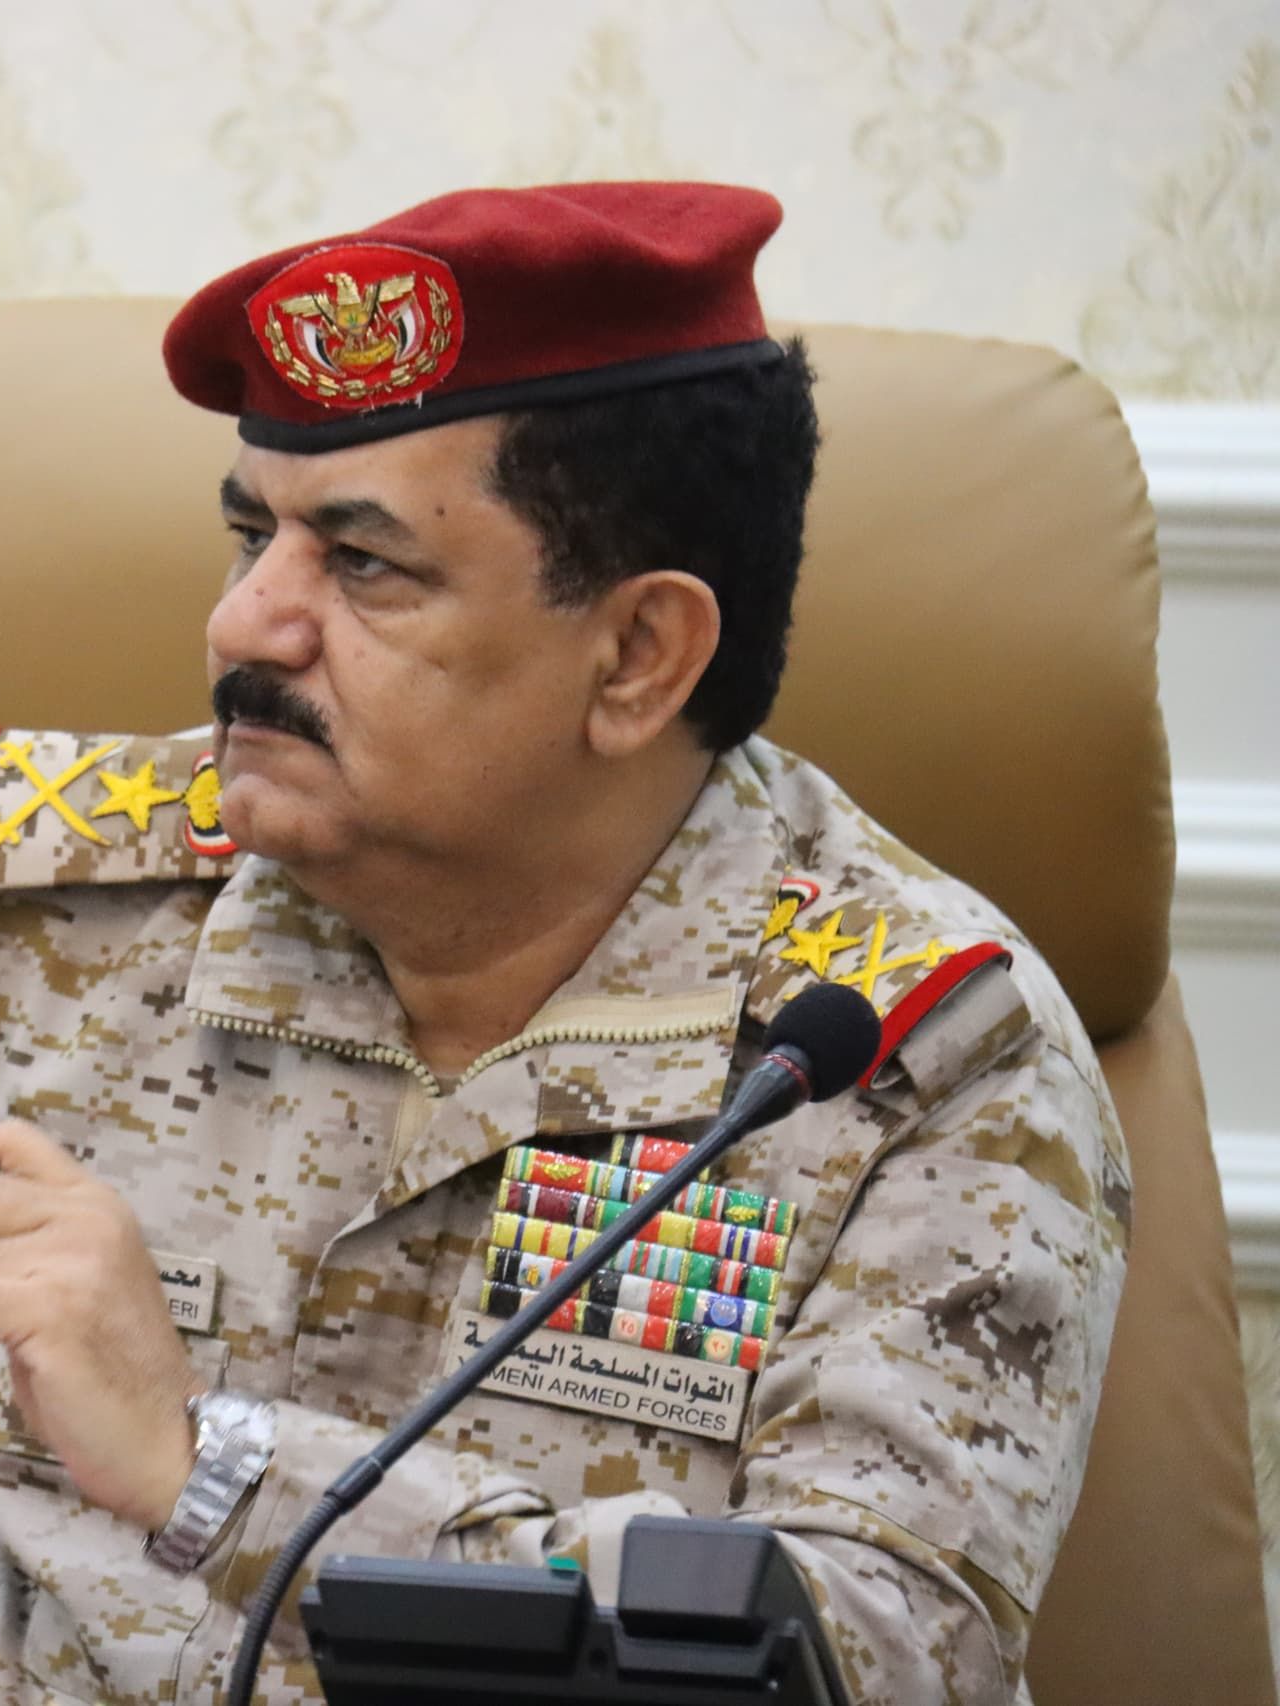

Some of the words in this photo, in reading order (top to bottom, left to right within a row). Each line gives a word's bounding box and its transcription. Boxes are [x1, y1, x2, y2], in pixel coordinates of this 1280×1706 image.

[159, 1269, 201, 1288] محس
[168, 1298, 199, 1319] ERI
[463, 1319, 566, 1372] اليمة
[569, 1343, 660, 1388] المسلحة
[457, 1354, 544, 1390] MENI
[547, 1376, 631, 1410] ARMED
[636, 1395, 728, 1433] FORCES
[663, 1367, 735, 1405] القوات
